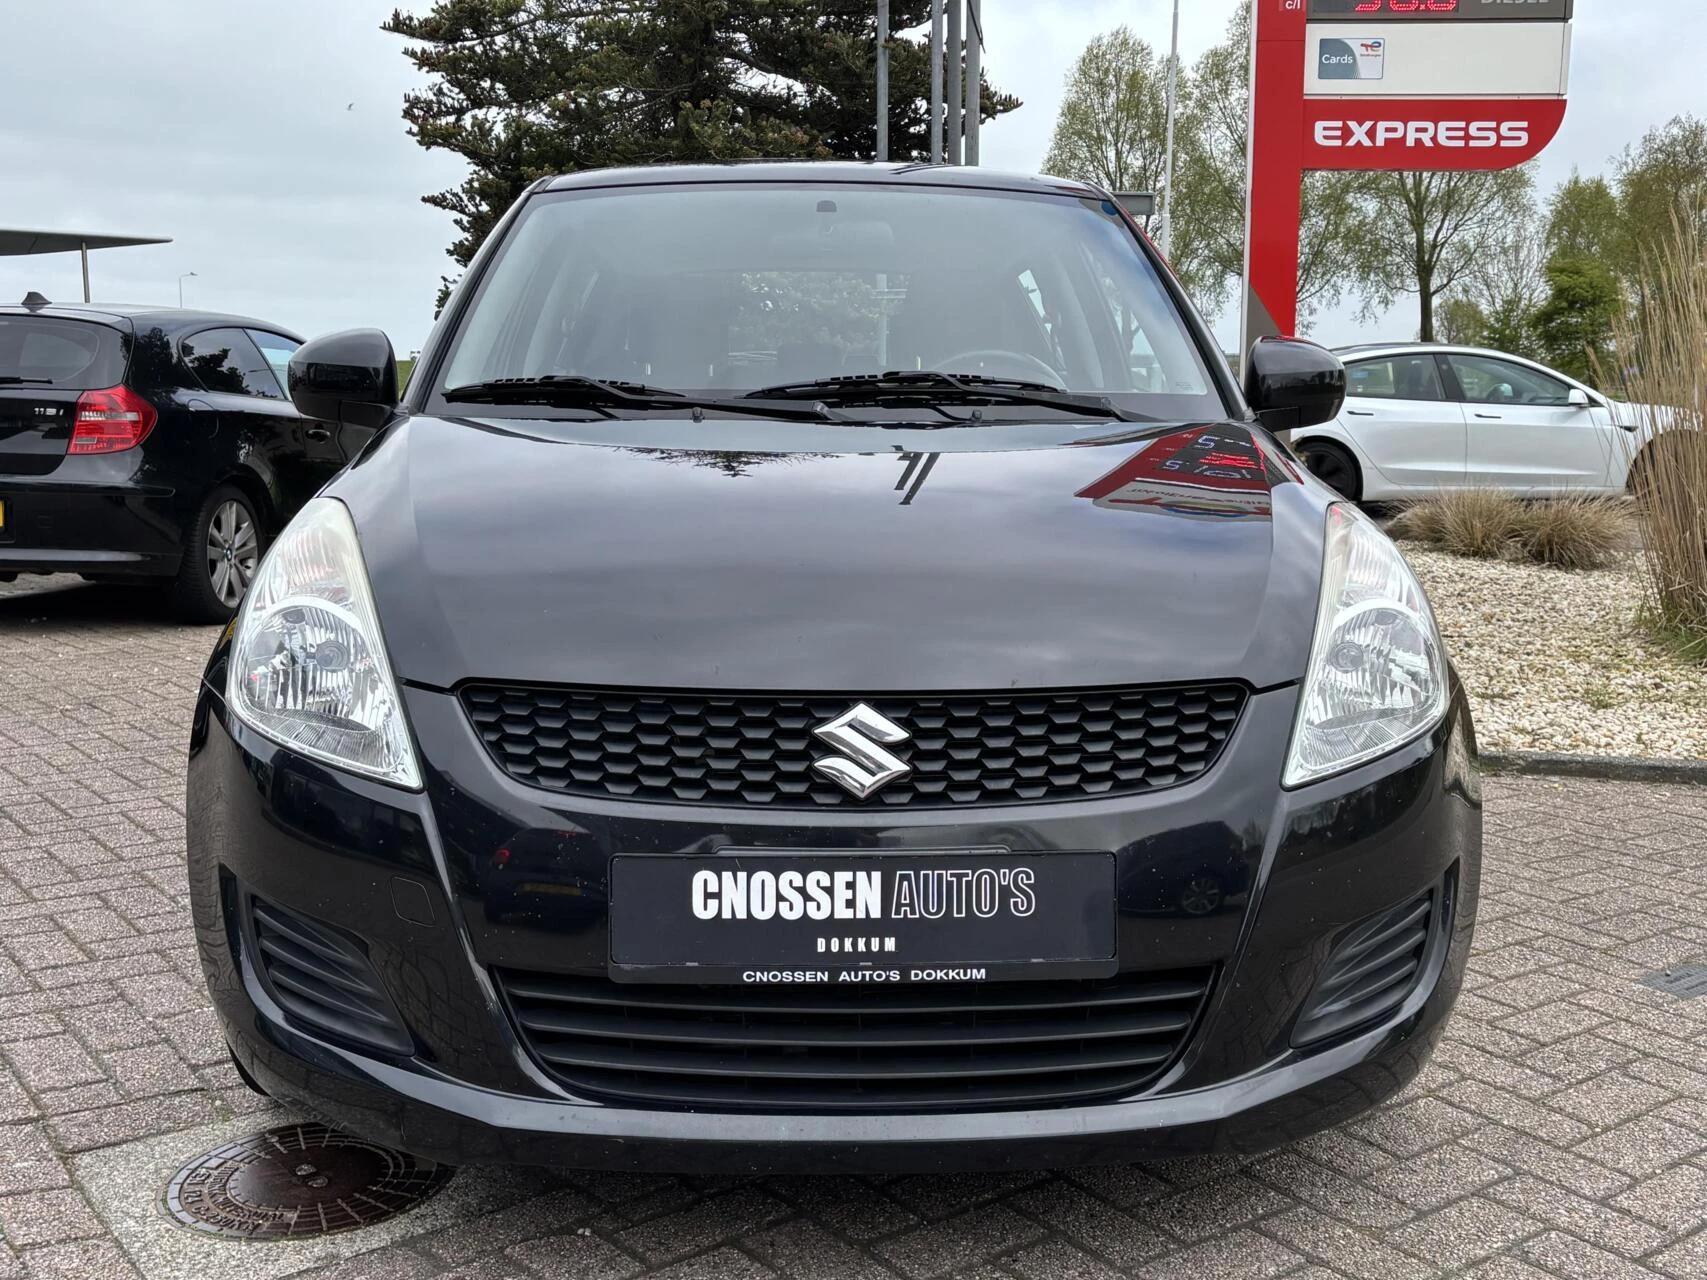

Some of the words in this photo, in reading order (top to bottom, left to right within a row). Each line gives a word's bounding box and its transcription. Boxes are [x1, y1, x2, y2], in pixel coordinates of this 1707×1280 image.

[1322, 54, 1353, 64] Cards
[1314, 121, 1529, 147] EXPRESS
[692, 870, 882, 920] CNOSSEN
[891, 868, 1036, 919] AUTO'S
[817, 937, 896, 952] DOKKUM
[742, 971, 829, 982] CNOSSEN
[838, 970, 901, 982] AUTO'S
[910, 969, 986, 981] DOKKUM
